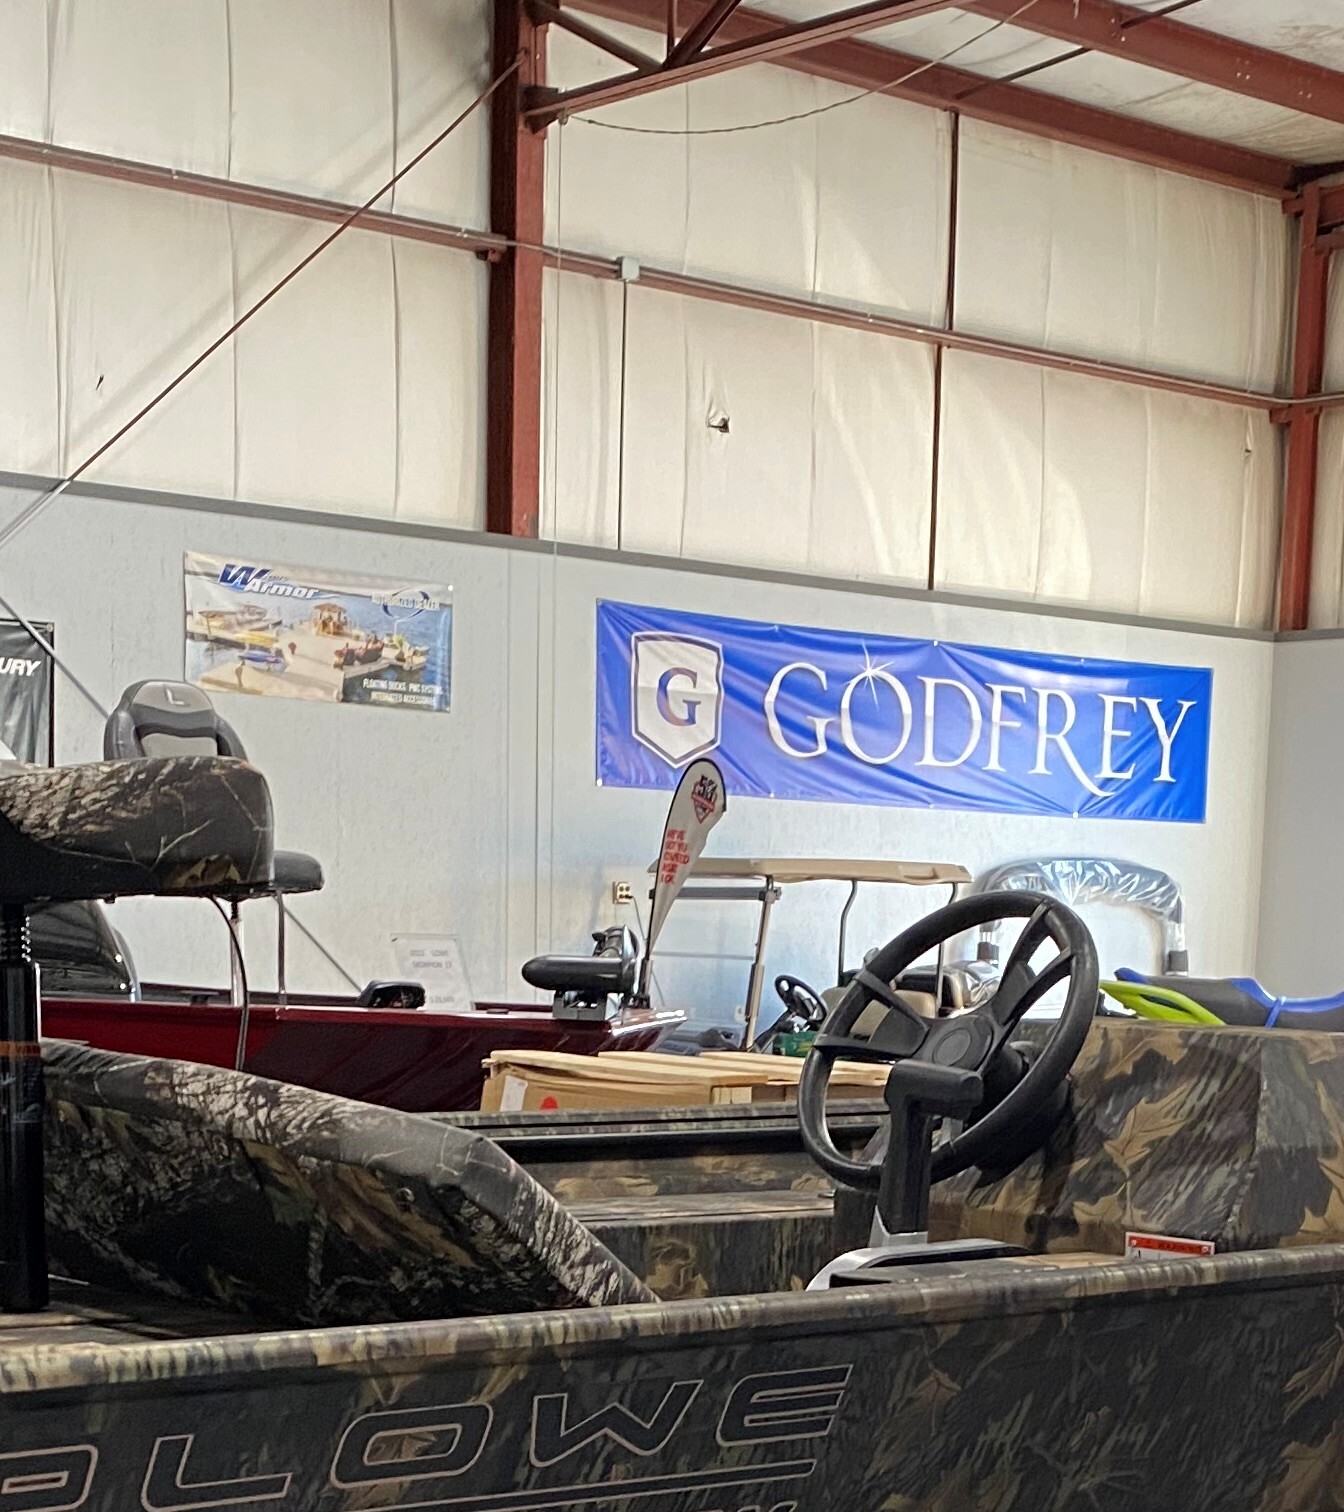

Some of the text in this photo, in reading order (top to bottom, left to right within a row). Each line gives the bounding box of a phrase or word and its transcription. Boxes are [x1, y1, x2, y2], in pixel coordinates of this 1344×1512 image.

[244, 578, 318, 599] Armor
[657, 667, 702, 728] G
[763, 659, 1198, 798] GODFREY
